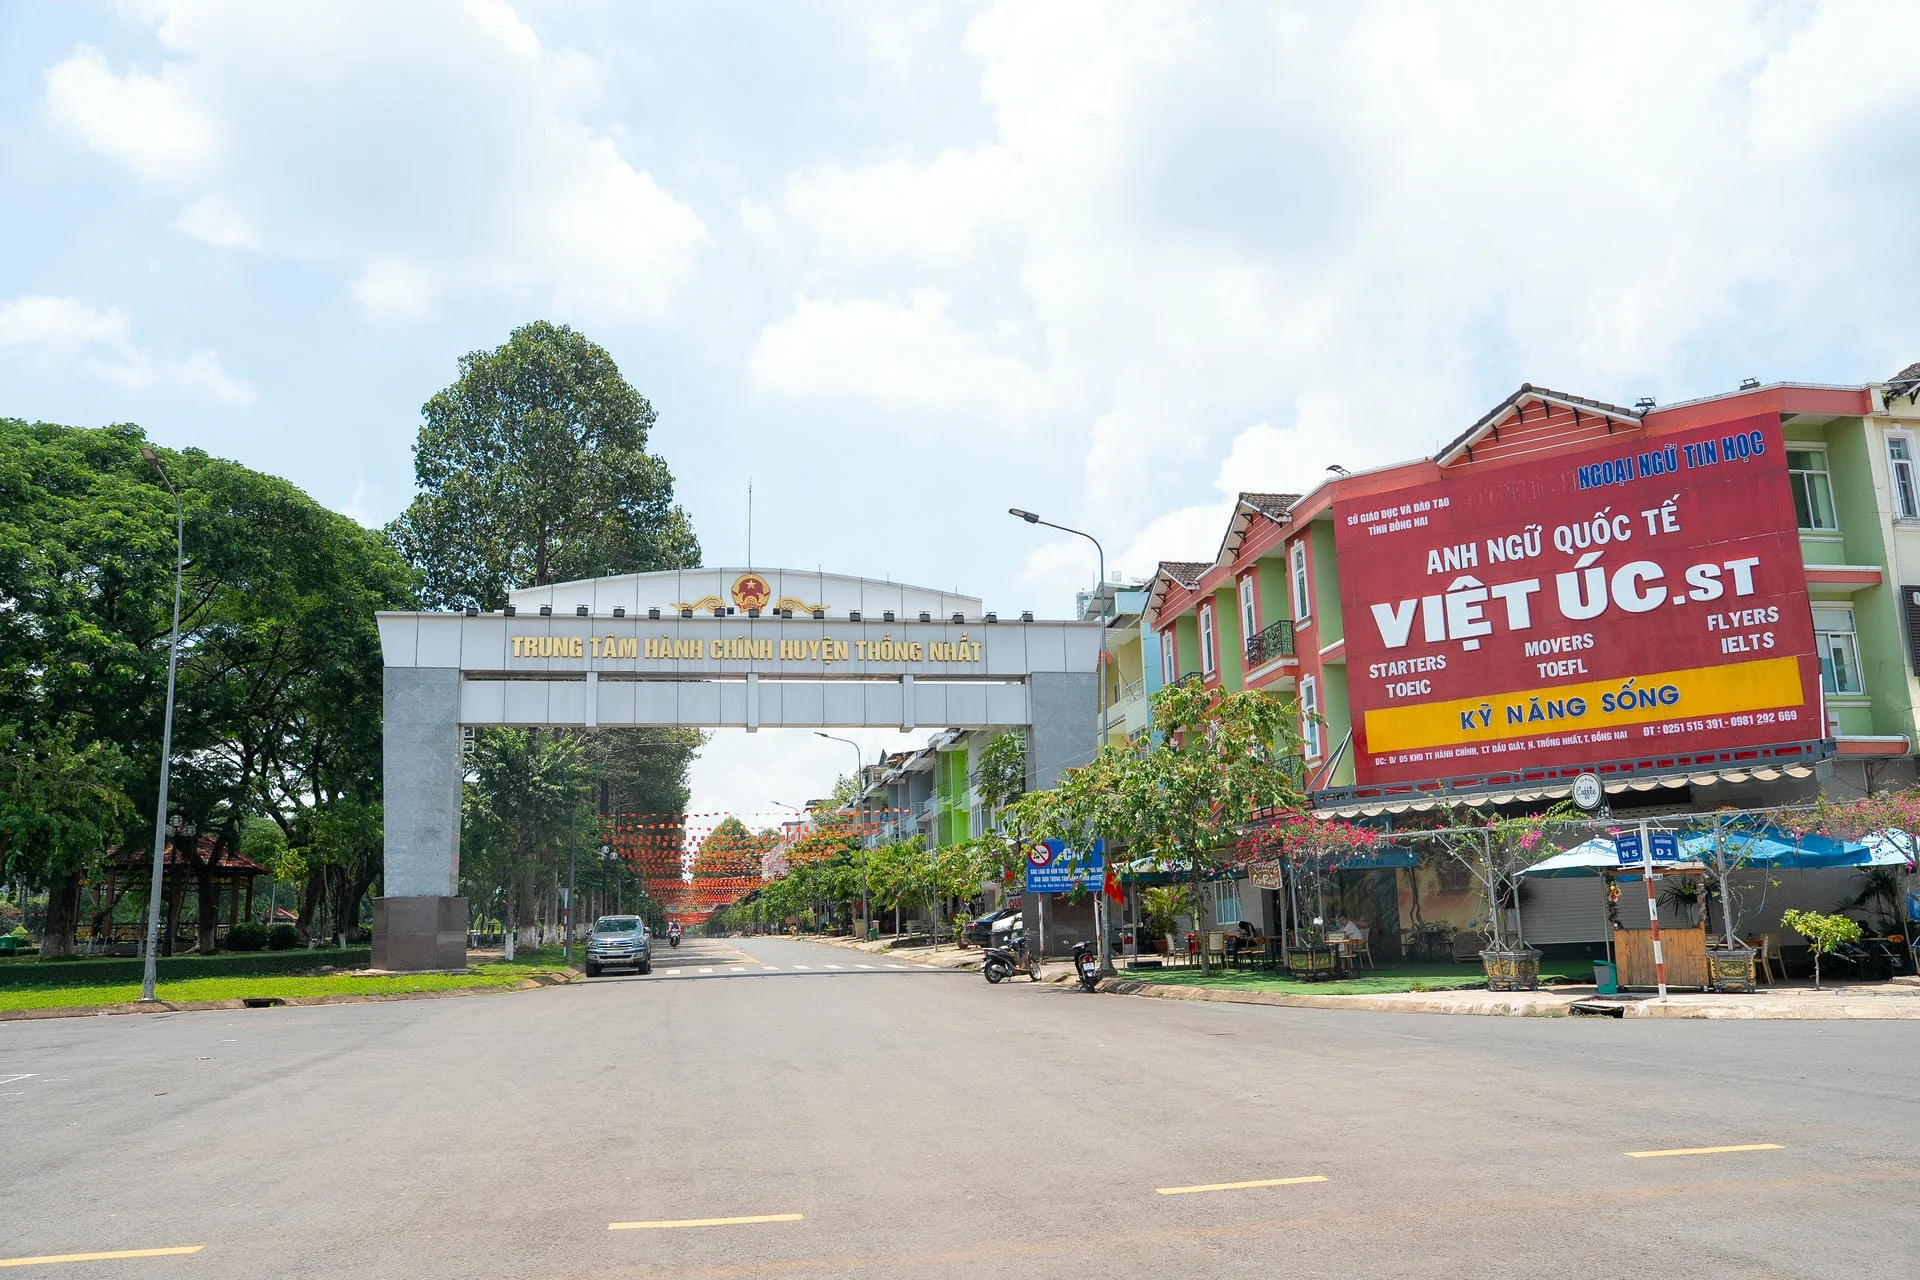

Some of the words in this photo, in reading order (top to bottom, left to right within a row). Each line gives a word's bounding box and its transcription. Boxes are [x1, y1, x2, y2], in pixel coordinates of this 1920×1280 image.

[1578, 456, 1636, 491] NGOẠI
[1639, 444, 1679, 479] NGỮ
[1684, 440, 1717, 469] TIN
[1721, 430, 1766, 465] HỌC
[1347, 513, 1360, 526] SỞ
[1360, 510, 1380, 523] GIÁO
[1381, 507, 1399, 520] DỤC
[1400, 504, 1412, 516] VÀ
[1413, 500, 1431, 513] ĐÀO
[1433, 496, 1450, 510] TẠO
[1368, 523, 1388, 536] TỈNH
[1389, 518, 1412, 532] ĐỒNG
[1413, 516, 1429, 528] NAI
[1426, 544, 1478, 576] ANH
[1486, 525, 1543, 563] NGỮ
[1553, 507, 1632, 555] QUỐC
[1641, 494, 1681, 537] TẾ
[1370, 575, 1541, 651] VIỆT
[1556, 550, 1760, 621] ÚC.ST
[1707, 606, 1780, 632] FLYERS
[511, 636, 584, 659] TRUNG
[589, 633, 638, 659] TÂM
[644, 633, 704, 660] HÀNH
[709, 634, 773, 660] CHÍNH
[779, 635, 850, 666] HUYỆN
[855, 632, 922, 662] THỐNG
[928, 632, 983, 662] NHẤT
[1525, 633, 1595, 658] MOVERS
[1721, 632, 1775, 654] IELTS
[1369, 655, 1447, 679] STARTERS
[1537, 658, 1588, 679] TOEFL
[1385, 678, 1432, 699] TOEIC
[1460, 702, 1493, 731] KỸ
[1506, 696, 1586, 725] NĂNG
[1602, 677, 1680, 713] SỐNG
[1662, 723, 1685, 734] 0251
[1687, 720, 1704, 731] 515
[1706, 718, 1723, 729] 391
[1730, 714, 1754, 727] 0981
[1756, 712, 1775, 724] 292
[1778, 710, 1798, 721] 669
[1409, 752, 1423, 762] KHU
[1424, 752, 1433, 761] TT
[1434, 749, 1454, 760] HÀNH
[1536, 735, 1561, 748] THỐNG
[1591, 730, 1613, 742] ĐỒNG
[1613, 730, 1628, 740] NAI
[1621, 850, 1630, 859] N
[1631, 849, 1639, 857] 5
[1655, 847, 1665, 856] D
[1666, 848, 1673, 856] 1
